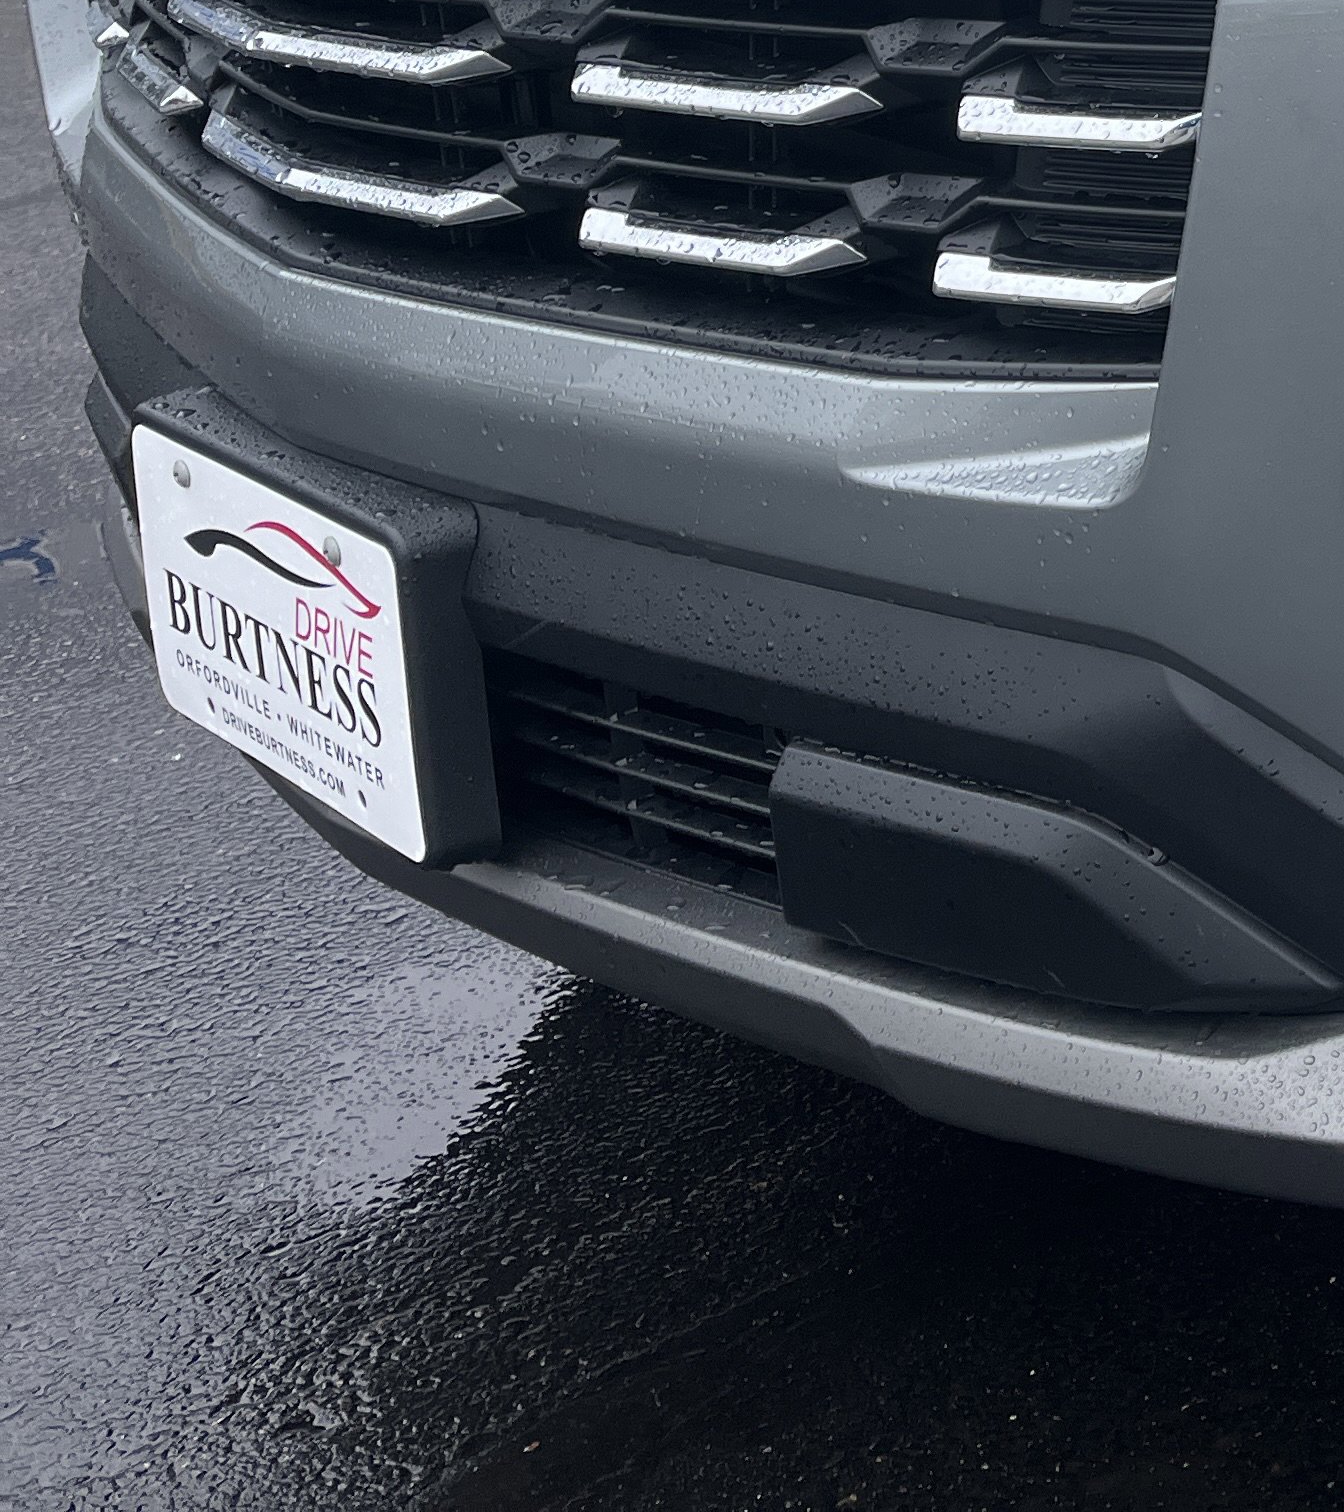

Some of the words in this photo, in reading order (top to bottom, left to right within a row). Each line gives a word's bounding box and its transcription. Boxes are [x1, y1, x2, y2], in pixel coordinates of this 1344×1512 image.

[163, 567, 382, 748] BURTNESS
[294, 597, 374, 679] DRIVE
[176, 649, 271, 721] ORFORDVILLE
[288, 714, 386, 790] WHITEWATER
[222, 706, 346, 798] DRIVEBURTNESS.COM
